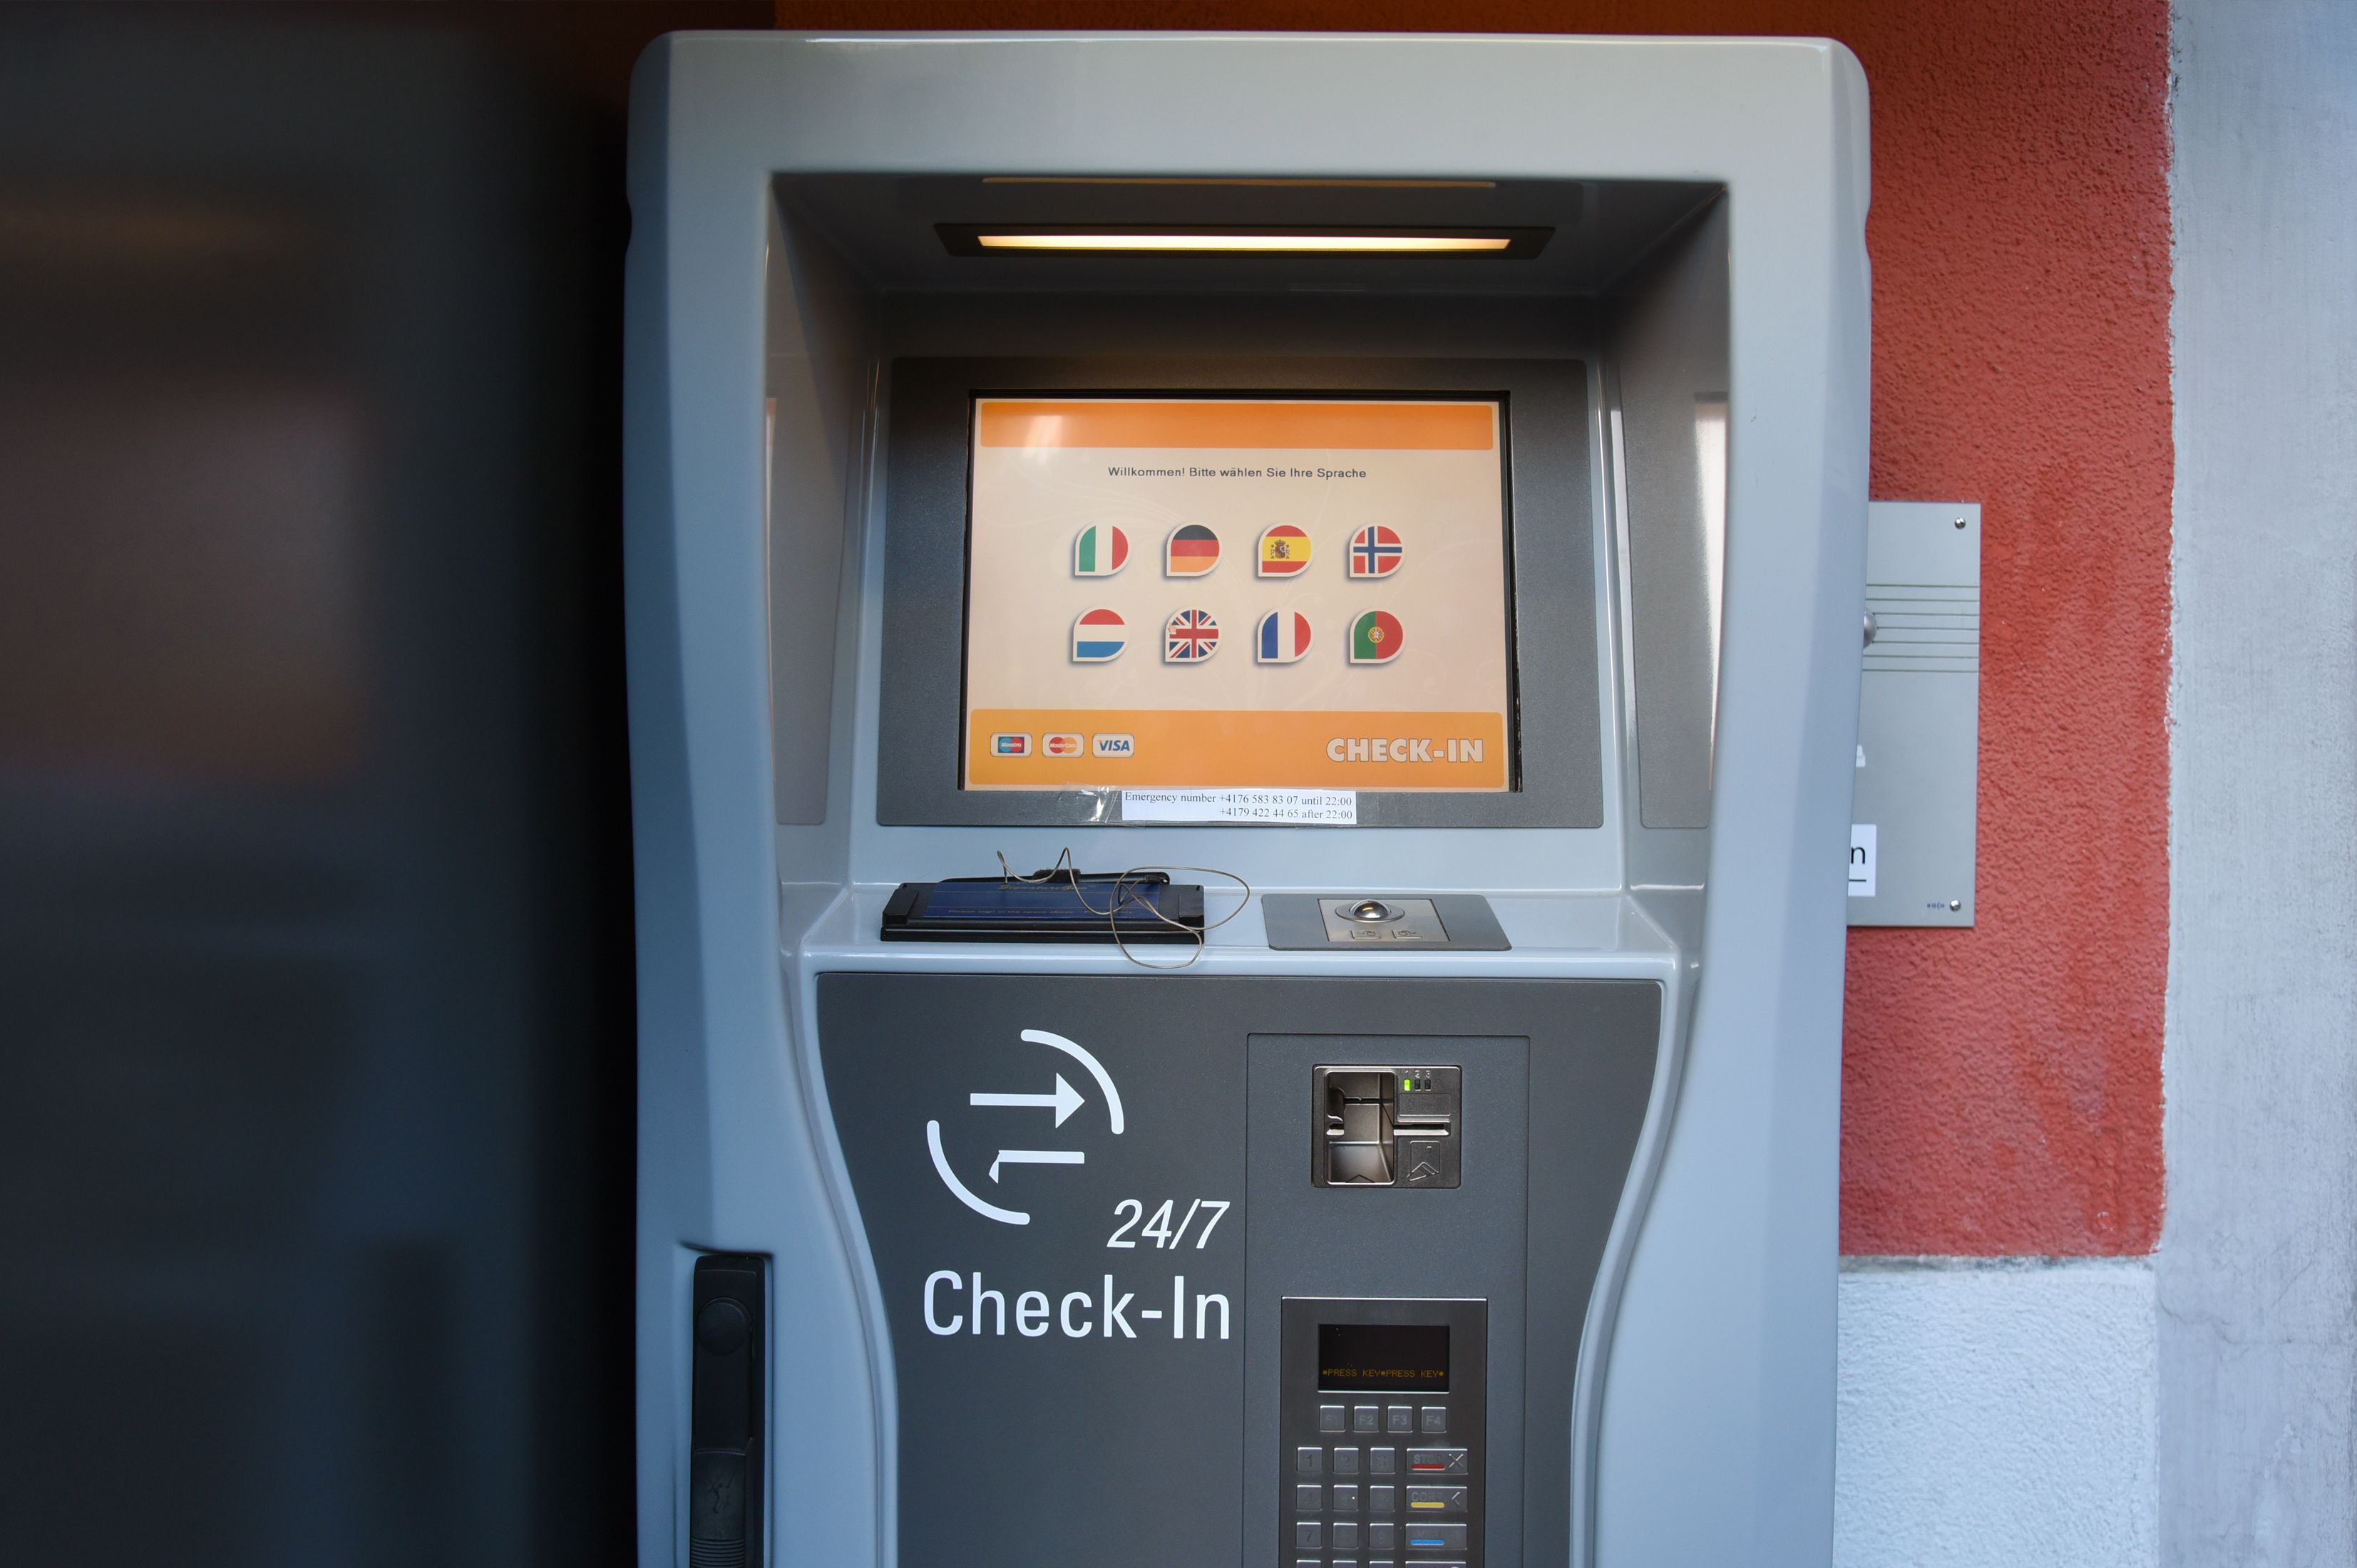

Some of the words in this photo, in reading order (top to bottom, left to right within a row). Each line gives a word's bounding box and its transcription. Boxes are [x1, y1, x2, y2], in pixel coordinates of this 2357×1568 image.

[1108, 467, 1185, 478] Willkommen!
[1189, 467, 1216, 478] Bitte
[1220, 467, 1263, 478] wählen
[1266, 468, 1286, 478] Sie
[1290, 468, 1313, 478] Ihre
[1316, 468, 1367, 480] Sprache
[1098, 740, 1130, 751] VISA
[1326, 737, 1484, 763] CHECK-IN
[1125, 792, 1177, 804] Emergency
[1181, 793, 1216, 803] number
[1219, 793, 1249, 804] +4176
[1252, 794, 1269, 804] 583
[1272, 795, 1283, 805] 83
[1286, 795, 1298, 805] 07
[1301, 796, 1323, 805] until
[1325, 797, 1352, 806] 22:00
[1219, 807, 1250, 817] +4179
[1252, 808, 1270, 817] 422
[1273, 809, 1284, 817] 44
[1287, 809, 1299, 818] 65
[1301, 809, 1323, 819] after
[1325, 810, 1352, 820] 22:00
[1414, 1070, 1421, 1078] 2
[1106, 1199, 1231, 1249] 24/7
[923, 1270, 1230, 1340] Check-In
[1359, 1415, 1374, 1425] F2
[1392, 1415, 1407, 1425] F3
[1426, 1415, 1441, 1426] F4
[1306, 1454, 1313, 1468] 1
[1305, 1530, 1313, 1542] 7
